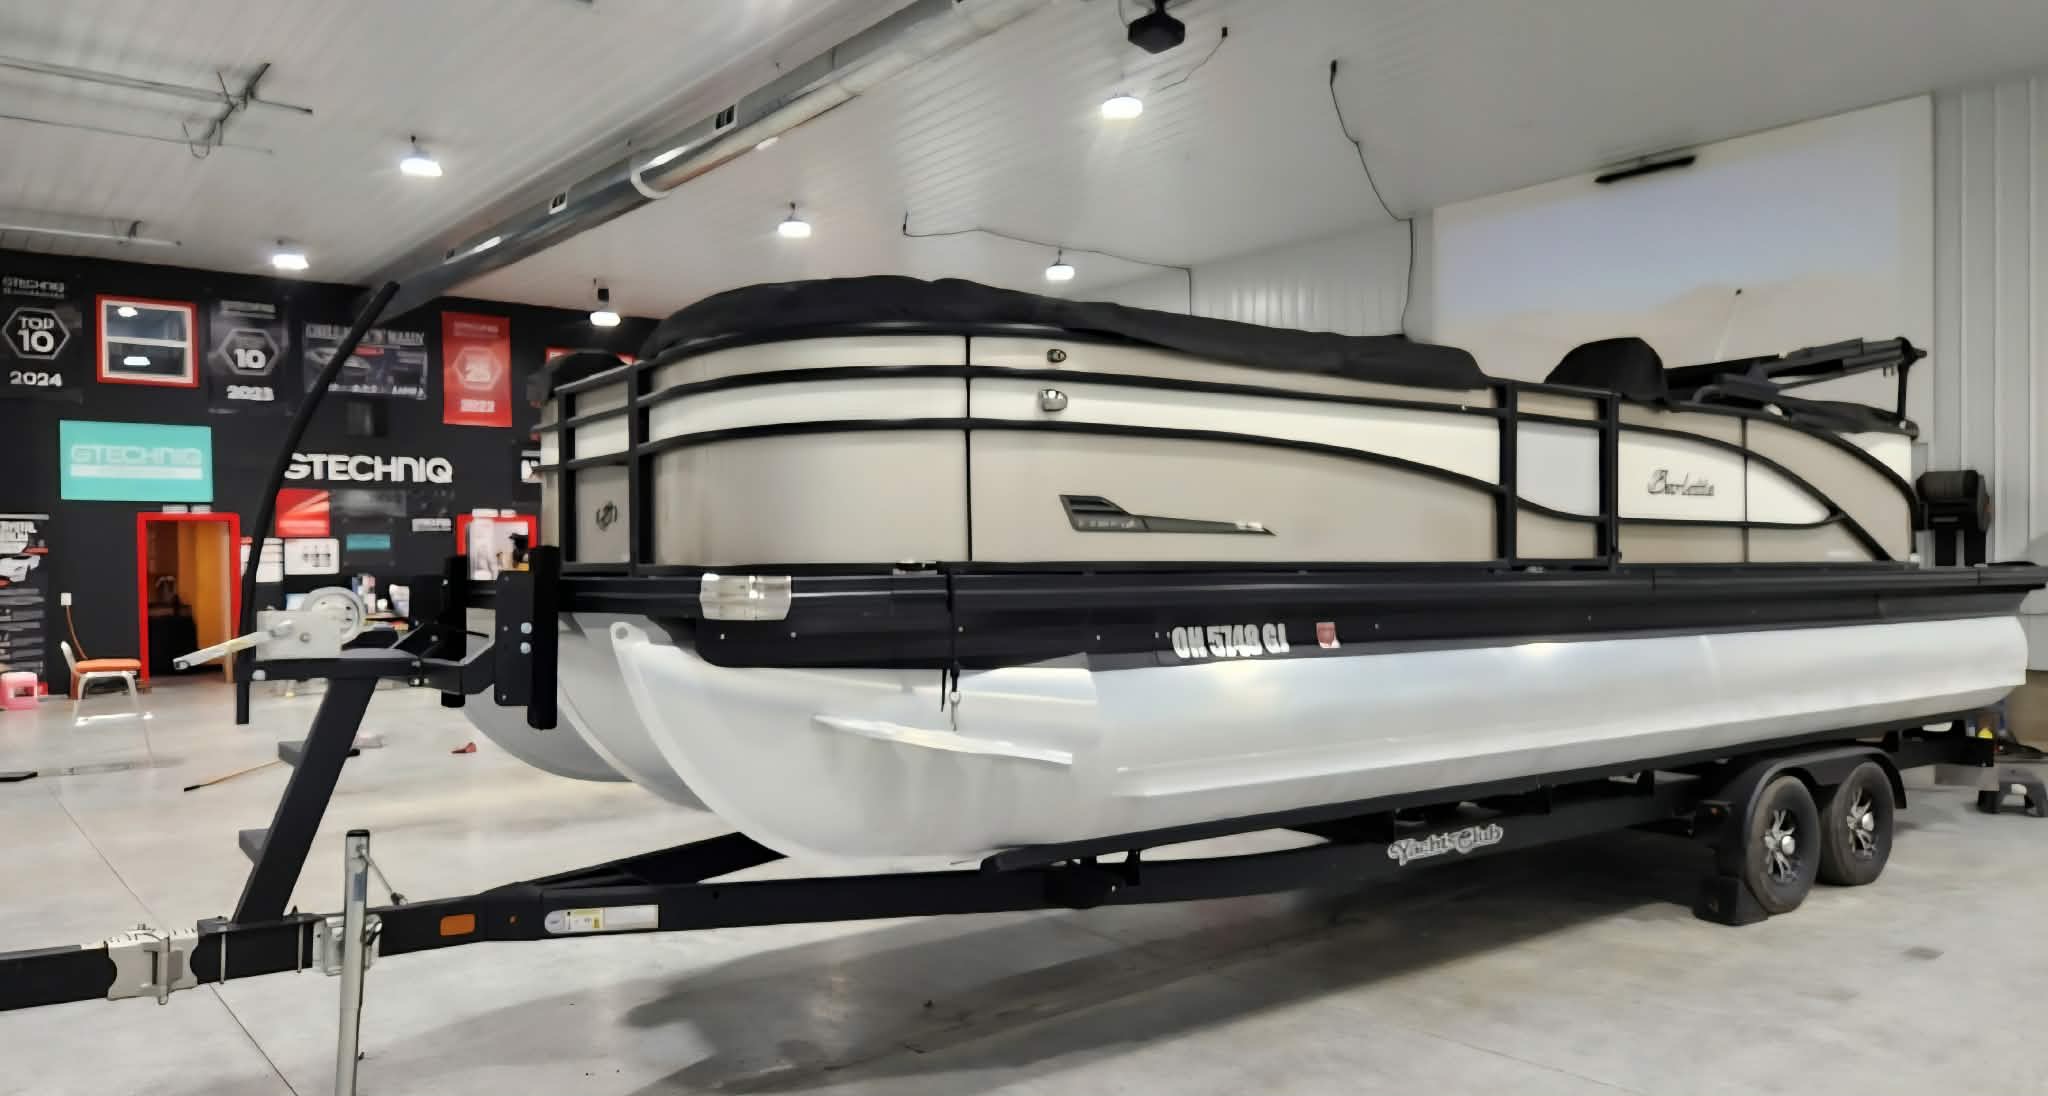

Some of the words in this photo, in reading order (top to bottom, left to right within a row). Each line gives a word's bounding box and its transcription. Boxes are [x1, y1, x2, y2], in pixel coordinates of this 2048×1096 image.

[17, 329, 55, 352] 10
[234, 348, 267, 369] 10
[9, 370, 63, 387] 2024
[1172, 626, 1208, 658] OH
